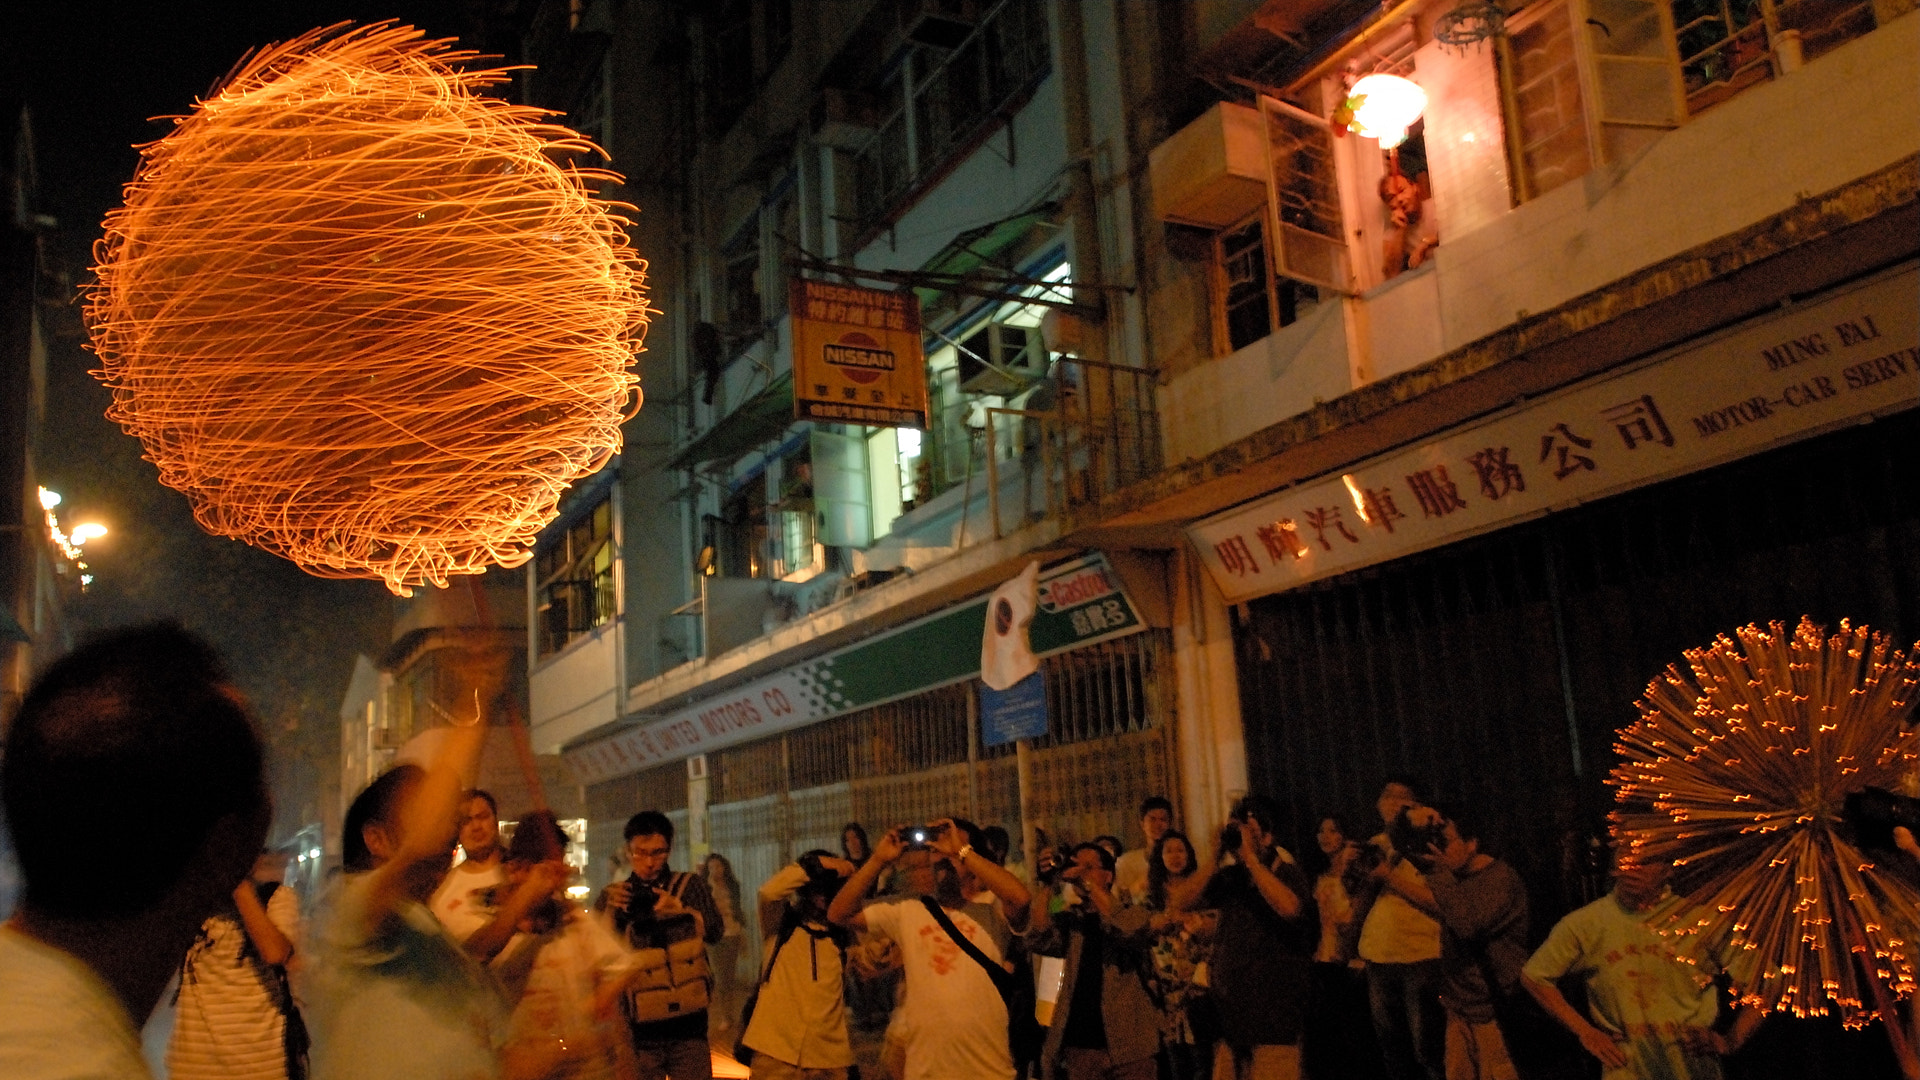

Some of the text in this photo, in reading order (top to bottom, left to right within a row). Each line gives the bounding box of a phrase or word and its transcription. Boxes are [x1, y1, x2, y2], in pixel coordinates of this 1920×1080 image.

[826, 346, 893, 369] NISSAN
[1761, 315, 1882, 372] MING FAI
[1692, 375, 1837, 438] MOTOR-CAR
[1213, 394, 1677, 579] 明輝汽車服務公司
[1050, 571, 1113, 607] Castrol
[657, 686, 793, 752] UNITED MOTORS CO
